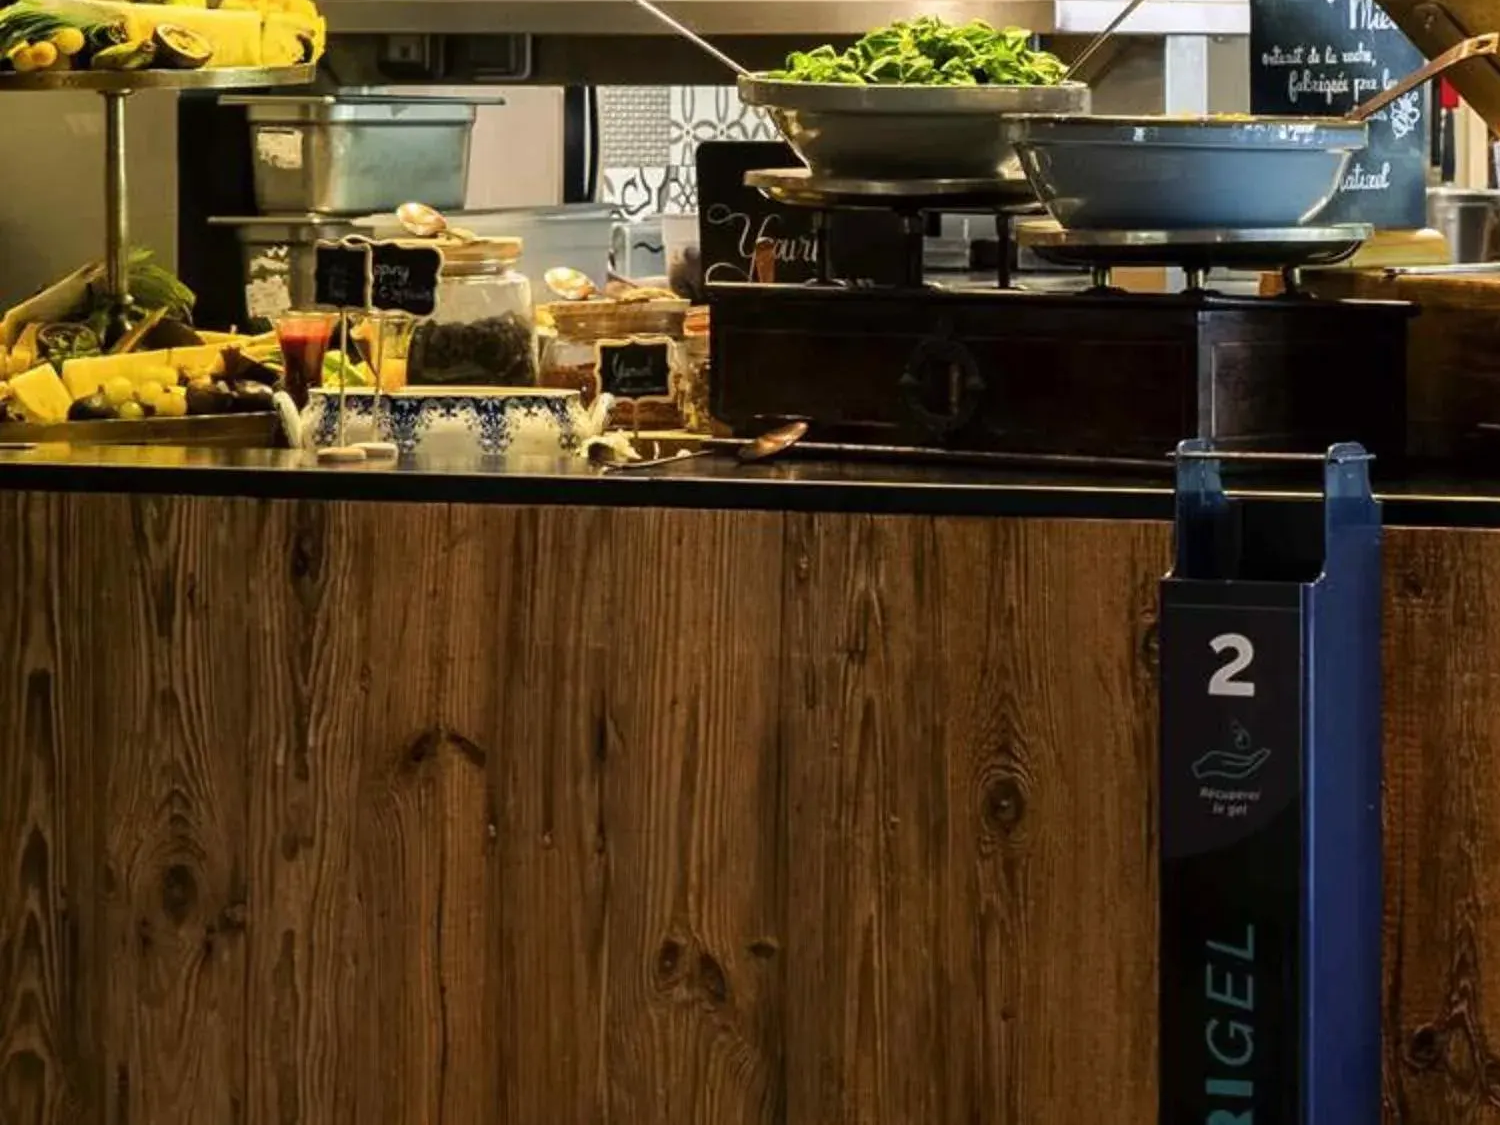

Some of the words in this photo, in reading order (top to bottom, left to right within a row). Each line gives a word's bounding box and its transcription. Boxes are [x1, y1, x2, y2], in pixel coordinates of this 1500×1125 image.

[1307, 45, 1320, 64] de
[1325, 45, 1338, 64] la
[1208, 632, 1255, 697] 2
